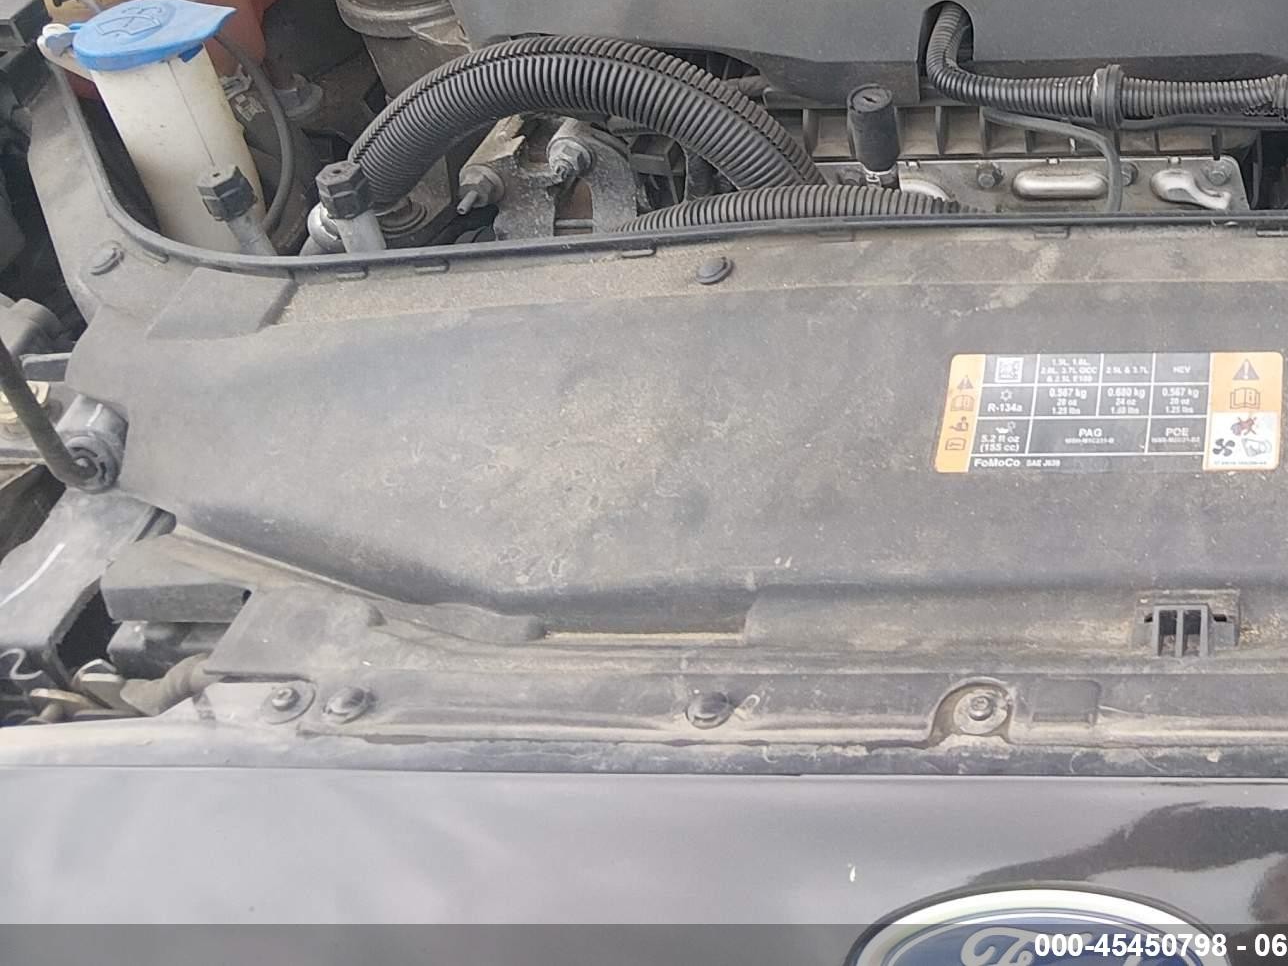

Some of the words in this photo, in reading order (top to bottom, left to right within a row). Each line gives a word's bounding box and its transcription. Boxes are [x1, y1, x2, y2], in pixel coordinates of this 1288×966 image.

[1075, 387, 1087, 399] kg
[1134, 387, 1146, 399] kg
[1187, 387, 1199, 399] kg
[987, 402, 1023, 412] R-134a
[1078, 428, 1103, 437] PAG
[1165, 427, 1189, 437] POE
[980, 434, 996, 443] 5.2
[980, 443, 1002, 452] (155
[1003, 443, 1020, 452] cc)
[974, 458, 1021, 467] FoMoCo
